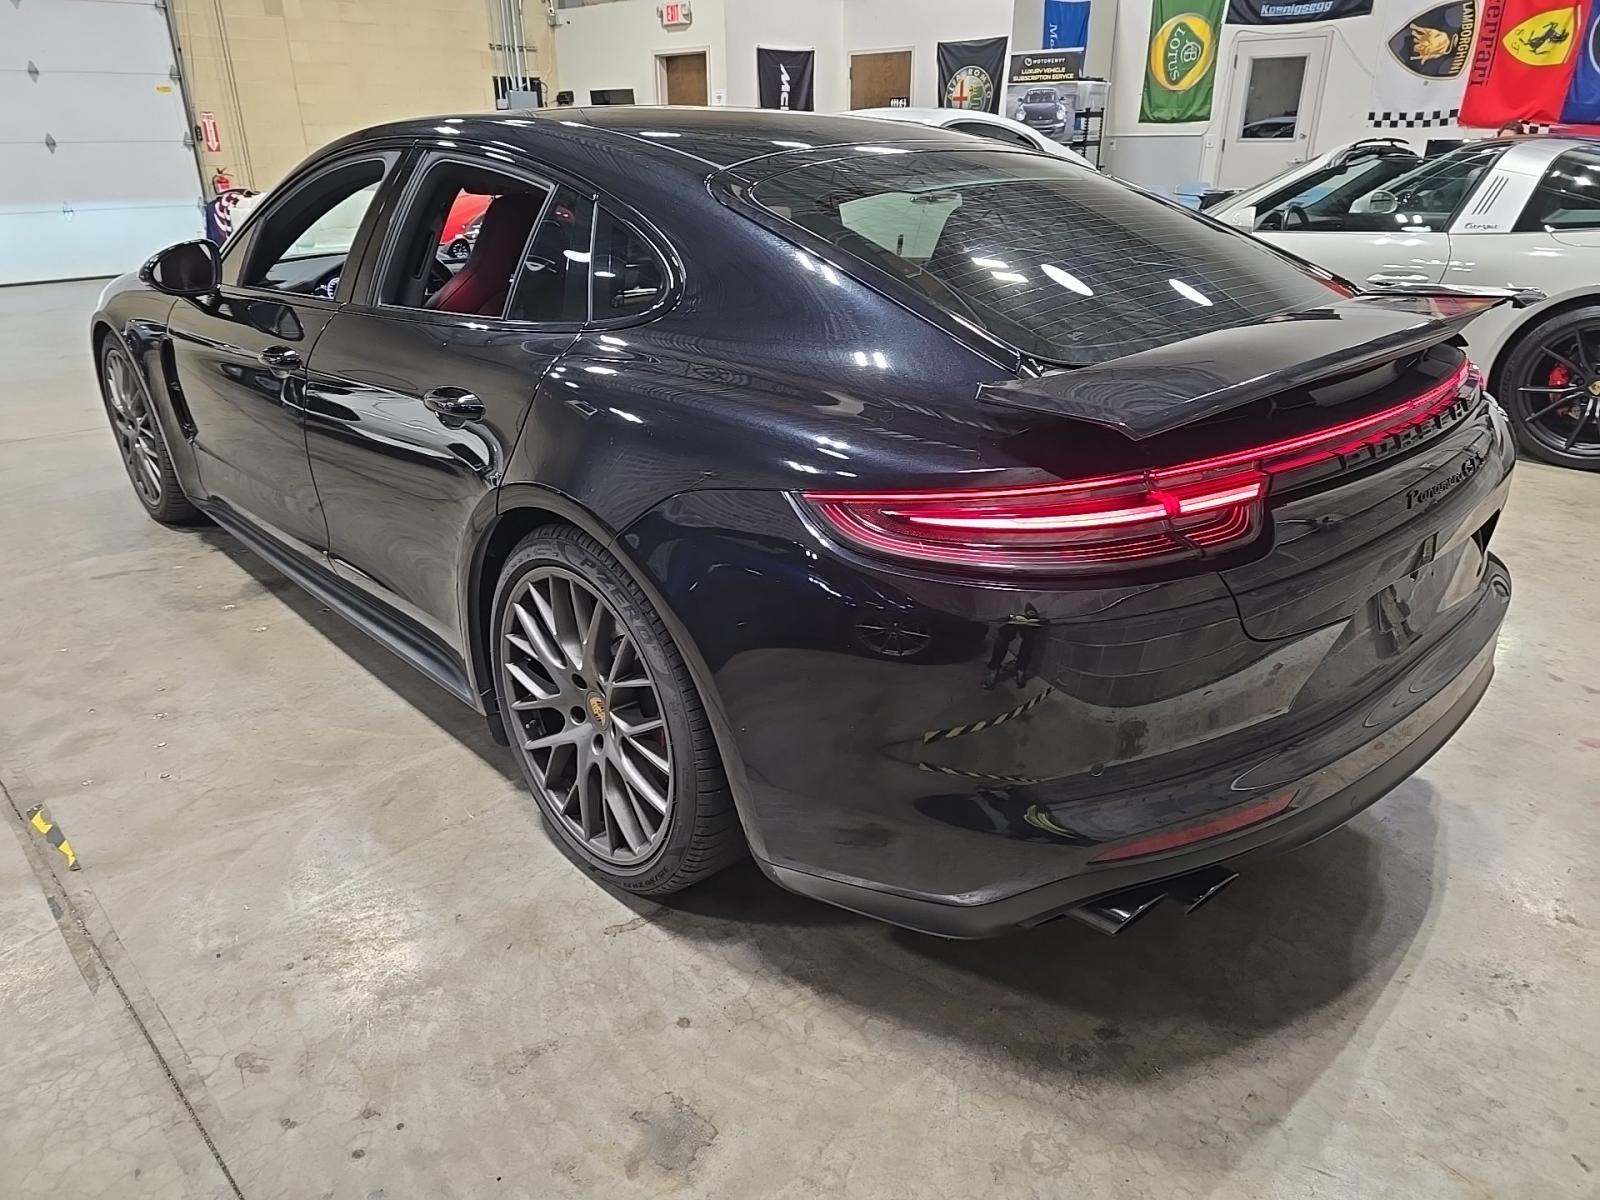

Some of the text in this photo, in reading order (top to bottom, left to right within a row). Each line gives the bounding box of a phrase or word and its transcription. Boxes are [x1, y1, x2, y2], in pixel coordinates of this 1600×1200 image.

[666, 4, 679, 22] EXIT
[1260, 1, 1333, 17] Koenigsegg
[1167, 26, 1186, 81] LOTUS
[1448, 2, 1475, 74] LAMBORGHINI
[1471, 0, 1503, 87] errari
